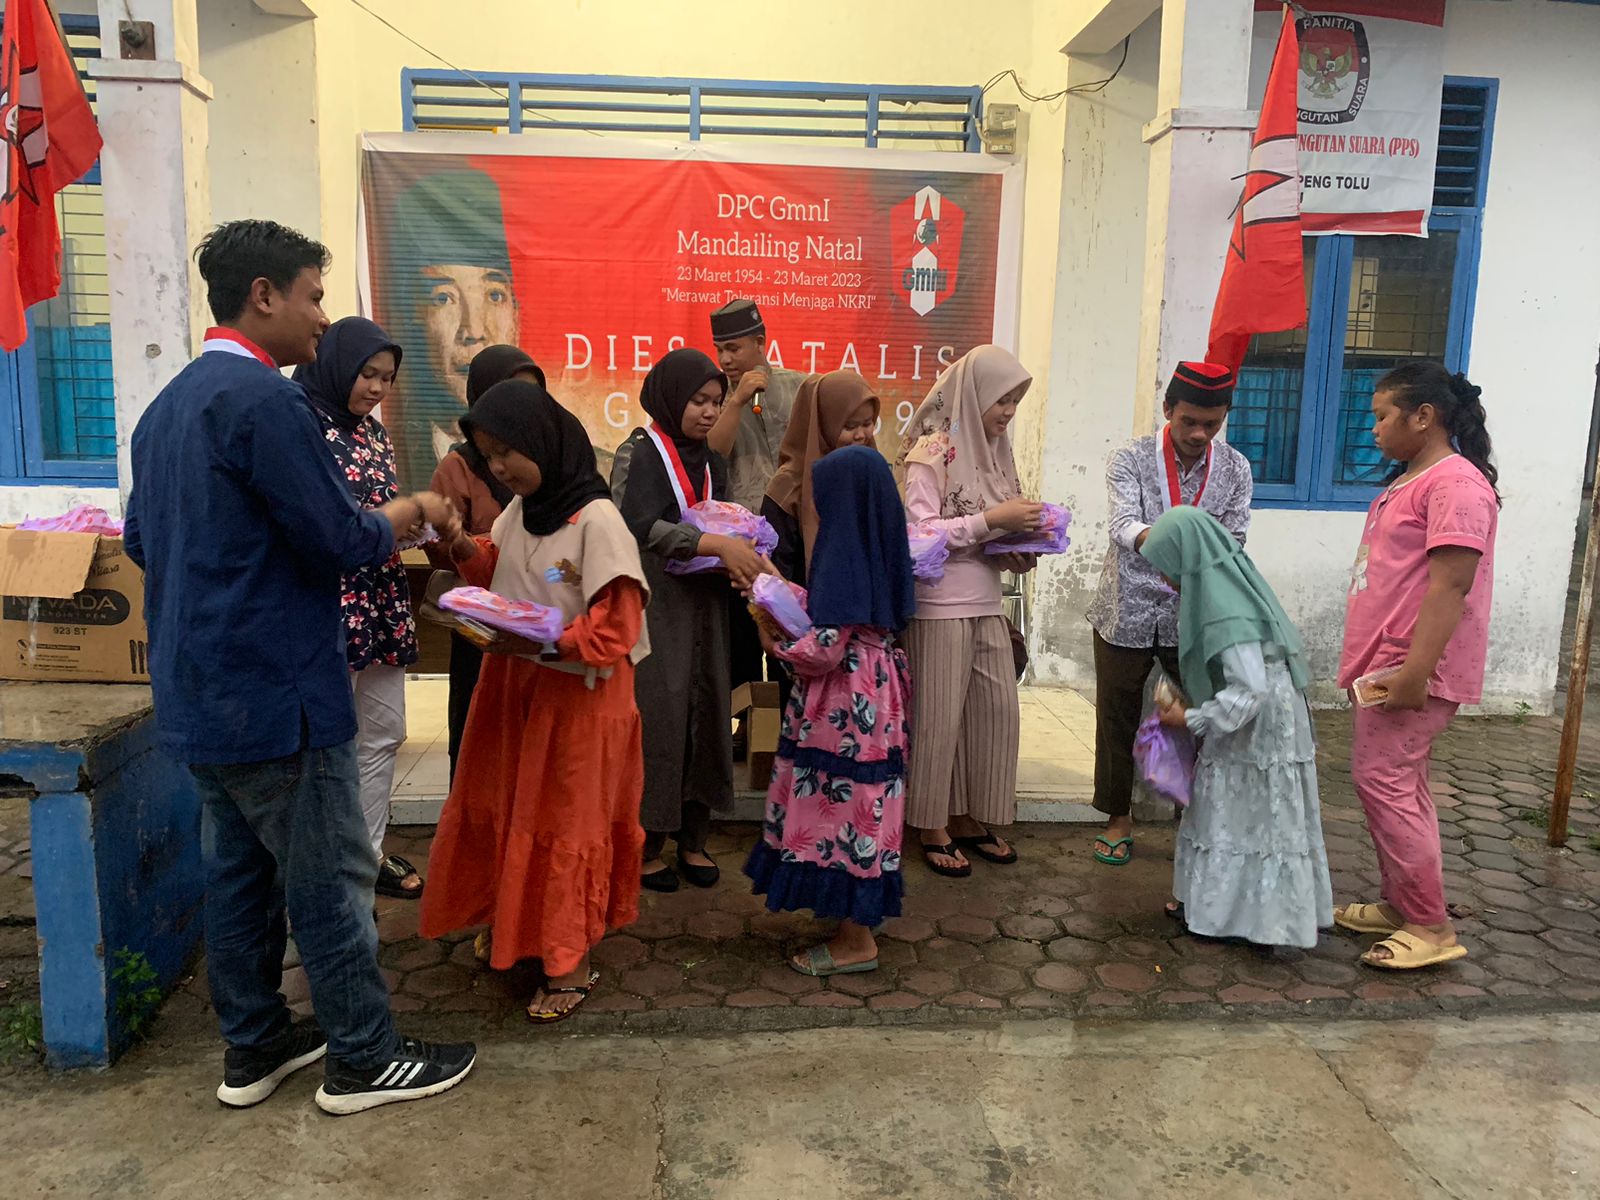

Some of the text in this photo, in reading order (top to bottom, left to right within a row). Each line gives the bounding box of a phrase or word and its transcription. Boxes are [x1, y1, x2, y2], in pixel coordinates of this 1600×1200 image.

[1303, 15, 1356, 32] PANITIA
[1348, 77, 1369, 117] SUARA
[1297, 133, 1420, 158] NGUTAN SUARA (PPS)
[1337, 176, 1370, 190] TOLU
[717, 193, 766, 220] DPC
[676, 230, 863, 264] Mandailing Natal
[676, 267, 692, 281] 23
[694, 267, 731, 283] Maret
[735, 269, 763, 285] 1954
[773, 270, 788, 286] 23
[790, 271, 828, 287] Maret
[831, 272, 862, 288] 2023
[661, 288, 876, 310] "Merawat Toleransi Menjaga NKRI"
[764, 339, 955, 380] ATALIS
[74, 627, 88, 635] ST
